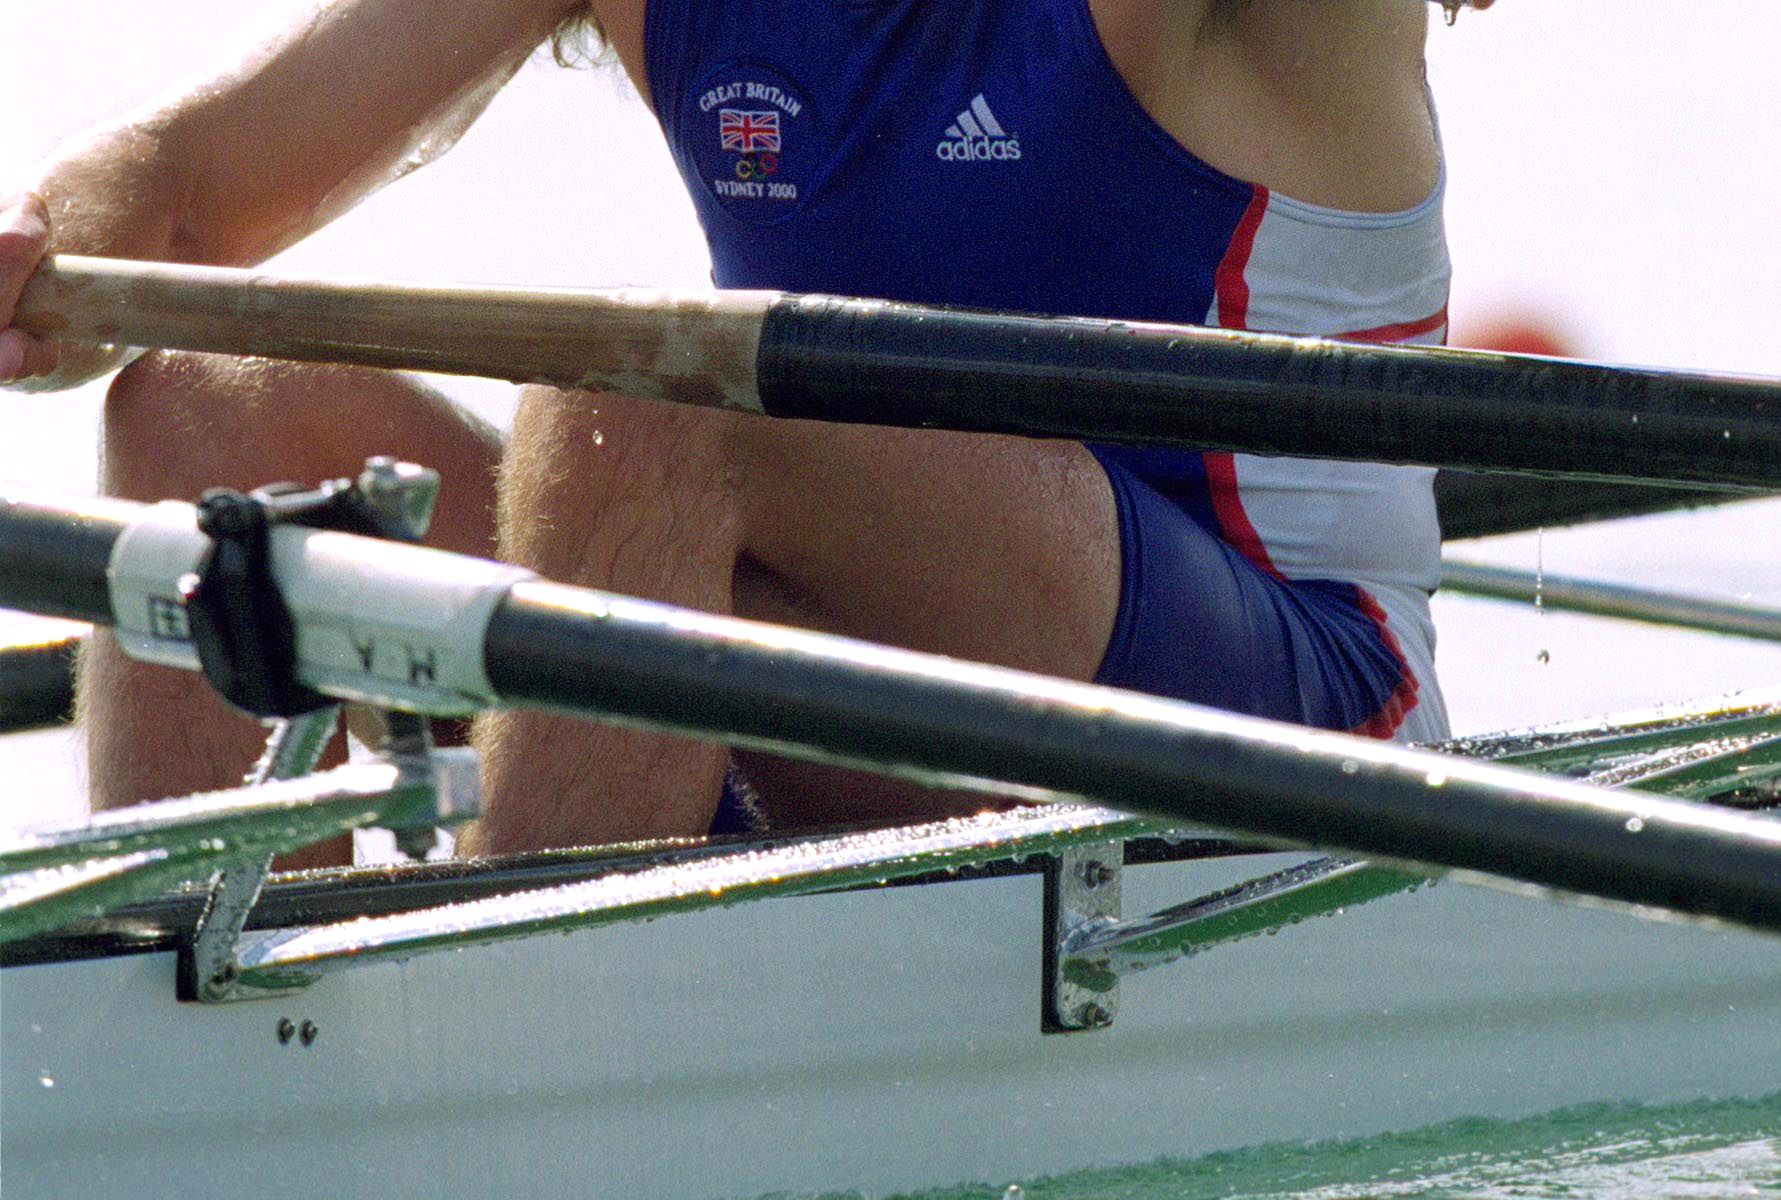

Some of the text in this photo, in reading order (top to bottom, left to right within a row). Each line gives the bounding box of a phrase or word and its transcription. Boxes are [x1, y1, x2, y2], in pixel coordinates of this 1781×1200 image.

[698, 81, 803, 118] GREAT BRITAIN
[936, 136, 1022, 162] adidas
[714, 179, 798, 200] SYDNEY 2000
